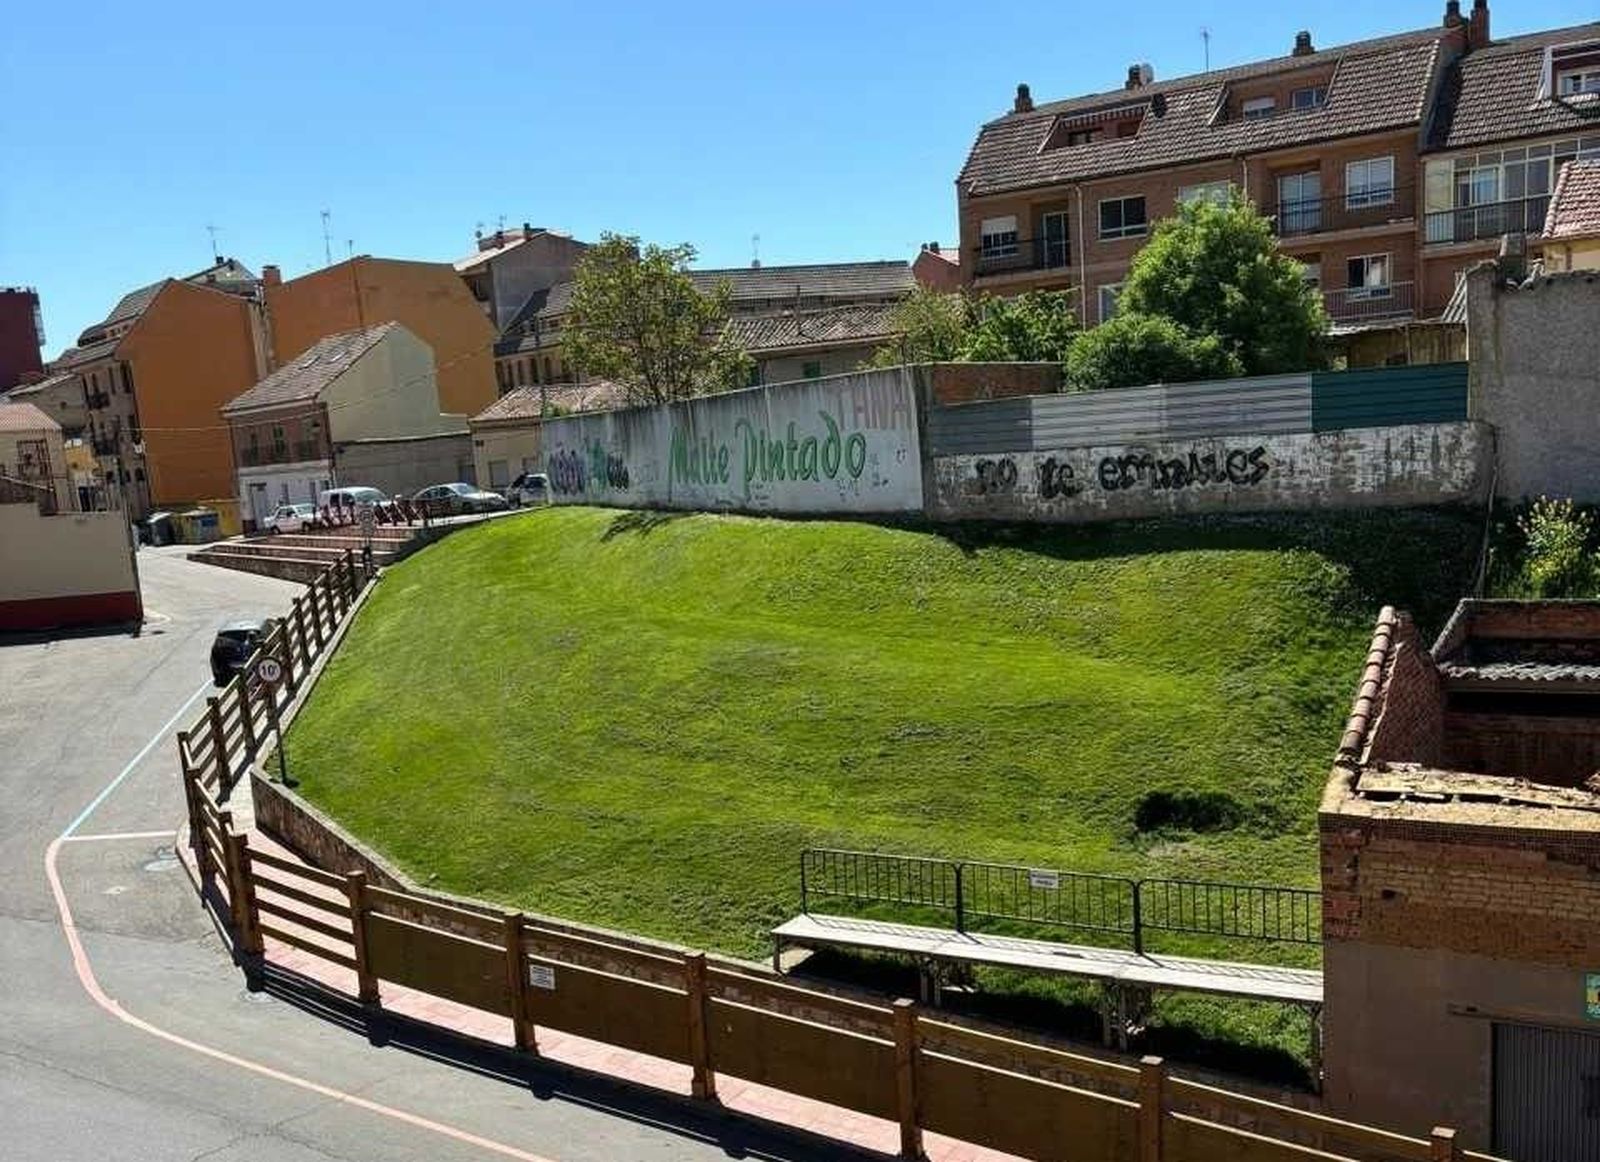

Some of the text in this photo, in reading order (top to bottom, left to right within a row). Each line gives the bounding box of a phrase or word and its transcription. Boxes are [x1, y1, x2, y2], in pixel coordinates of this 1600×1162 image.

[735, 410, 867, 502] Pintado
[976, 458, 1018, 493] no
[1038, 457, 1084, 499] te
